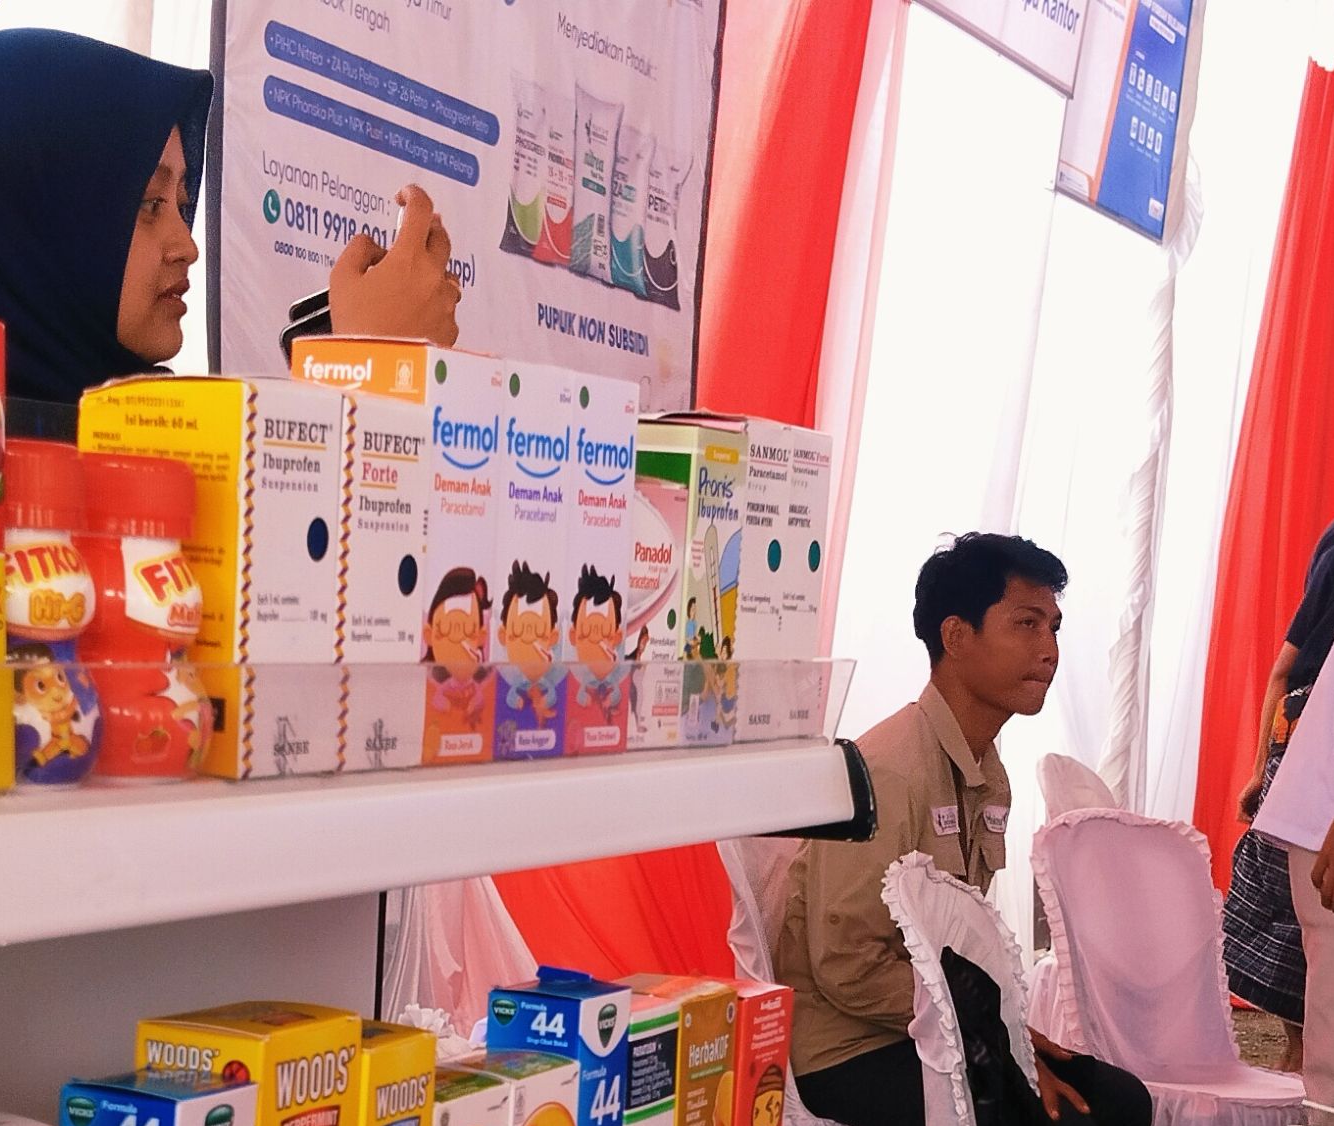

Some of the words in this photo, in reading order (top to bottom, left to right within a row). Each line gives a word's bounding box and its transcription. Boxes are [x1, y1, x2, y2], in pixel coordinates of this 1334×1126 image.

[349, 0, 390, 33] Tengah
[557, 12, 624, 64] Menyediakan
[263, 151, 319, 189] Layanan
[322, 171, 385, 214] Pelanggan
[285, 198, 318, 235] 0811
[323, 211, 357, 246] 9918
[274, 240, 294, 257] 0800
[537, 303, 575, 336] PUPUK
[578, 314, 605, 345] NON
[608, 322, 649, 357] SUBSIDI
[302, 355, 373, 386] fermol
[263, 418, 329, 445] BUFECT
[432, 405, 500, 454] fermol
[506, 416, 571, 462] fermol
[363, 431, 422, 456] BUFECT
[576, 427, 634, 470] fermol
[750, 443, 788, 463] SANMOL
[262, 452, 322, 475] Ibuprofen
[362, 461, 399, 484] Forte
[748, 465, 788, 483] Paracetamol
[261, 476, 319, 493] Suspension
[434, 473, 470, 494] Demam
[471, 477, 492, 497] Anak
[508, 481, 542, 502] Demam
[542, 485, 563, 504] Anak
[698, 466, 733, 499] Proris
[358, 495, 412, 517] Ibuprofen
[440, 498, 486, 517] Paracetamol
[578, 489, 607, 508] Demam
[608, 493, 627, 510] Anak
[514, 503, 557, 523] Paracetamol
[582, 510, 622, 529] Paracetamol
[697, 498, 739, 526] Ibuprofen
[357, 518, 410, 534] Suspension
[634, 541, 672, 565] Panadol
[493, 1006, 517, 1016] VICKS
[520, 1001, 548, 1012] Formula
[530, 1011, 566, 1038] 44
[598, 1017, 617, 1031] VICKS
[582, 1065, 607, 1081] Formula
[68, 1106, 95, 1119] VICKS
[100, 1100, 138, 1114] Formula
[589, 1074, 621, 1126] 44
